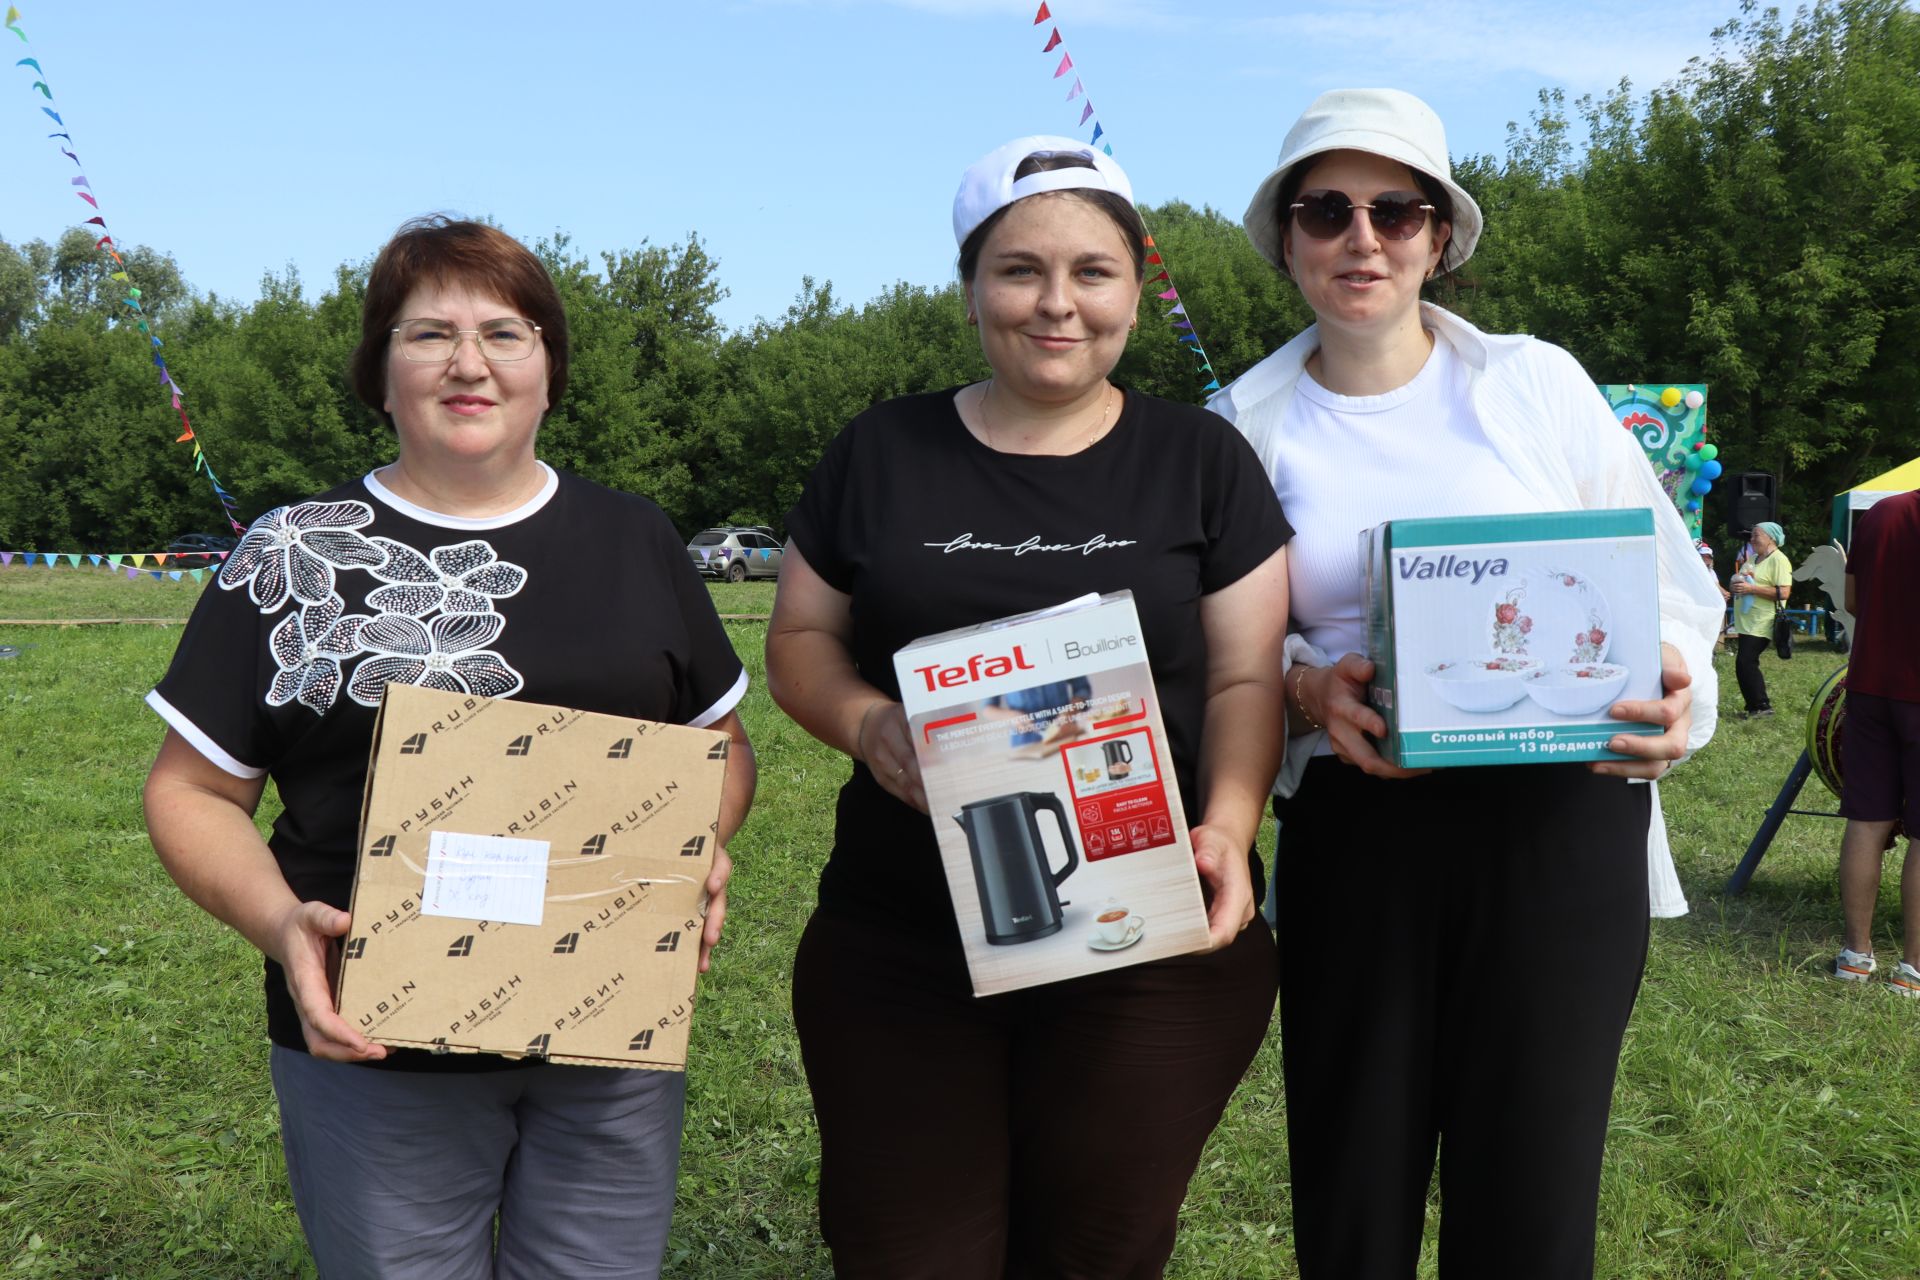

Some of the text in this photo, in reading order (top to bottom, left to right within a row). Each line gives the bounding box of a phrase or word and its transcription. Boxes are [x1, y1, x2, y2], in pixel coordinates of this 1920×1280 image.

[1399, 554, 1509, 585] Valleya
[913, 645, 1035, 692] Tefal
[1064, 634, 1137, 660] Bouilloire
[432, 696, 487, 733] RUB
[1431, 729, 1554, 743] Столовый набор
[1519, 741, 1610, 753] 13 предмето
[400, 776, 474, 832] РУБИН
[508, 779, 577, 834] RUBIN
[610, 781, 678, 834] RUBIN
[583, 881, 650, 932] RUBIN
[360, 981, 416, 1026] UBIN
[450, 975, 521, 1034] РУБИН
[554, 973, 624, 1030] РУБИН
